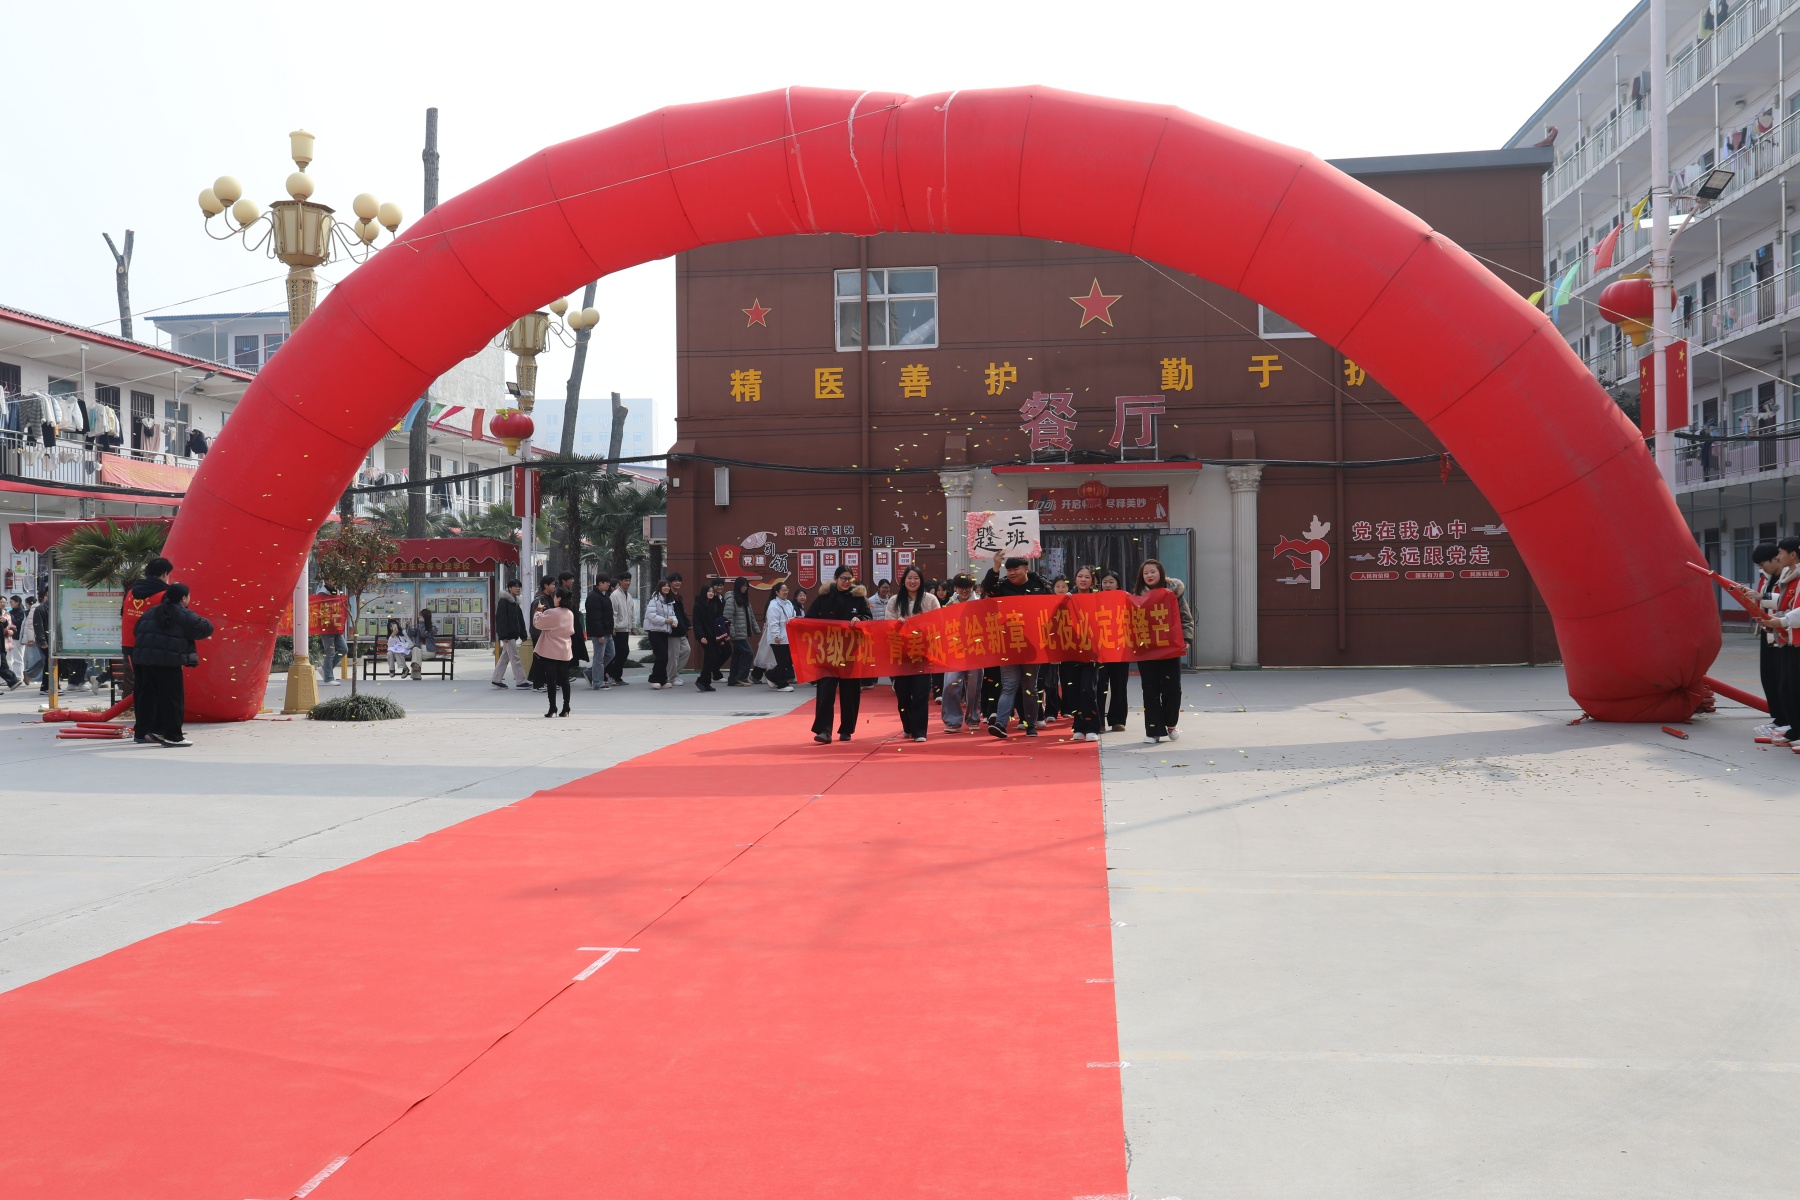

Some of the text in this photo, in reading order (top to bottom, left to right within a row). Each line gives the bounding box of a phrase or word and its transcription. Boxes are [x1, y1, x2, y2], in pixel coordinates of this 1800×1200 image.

[730, 362, 1018, 402] 精医善护
[1019, 391, 1165, 451] 餐厅
[1061, 499, 1103, 509] 开启
[784, 525, 854, 535] 强化五个引领
[1005, 516, 1030, 551] 二班
[1352, 519, 1467, 541] 党在我心中
[1377, 545, 1490, 566] 永远跟党走
[801, 603, 1171, 667] 23级2班 青春执笔绘新章 此役必定绽锋芒
